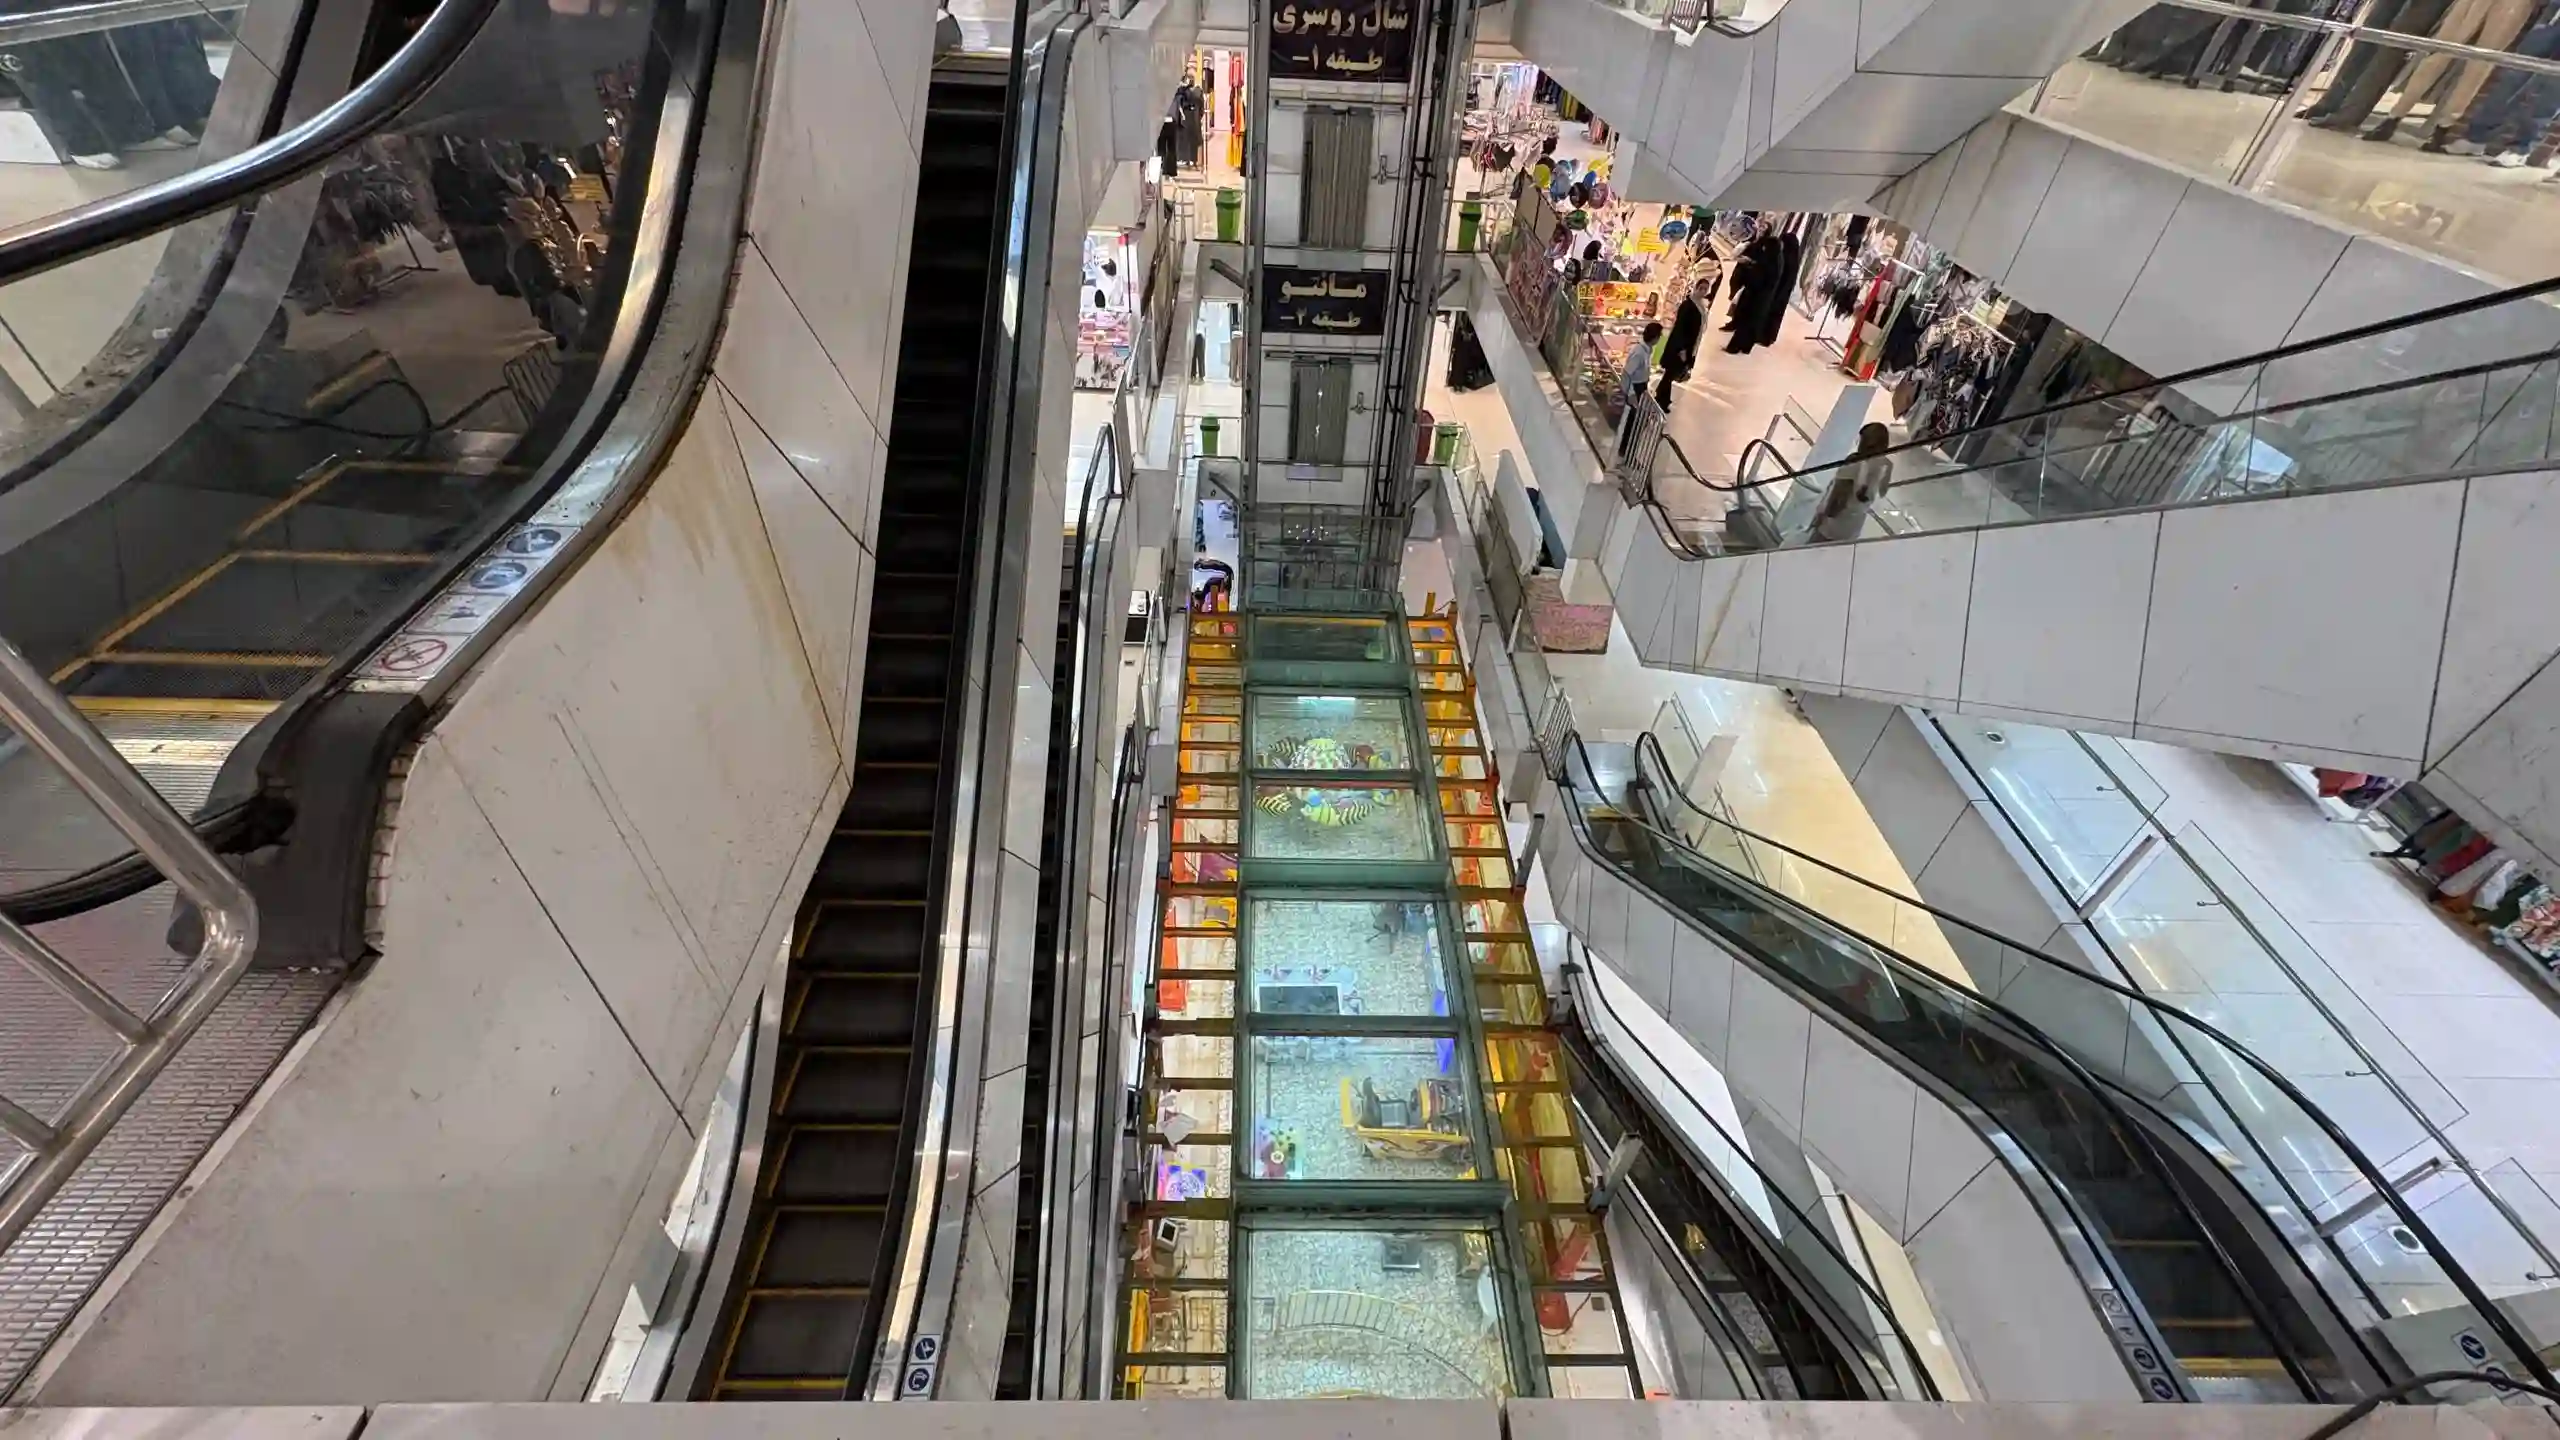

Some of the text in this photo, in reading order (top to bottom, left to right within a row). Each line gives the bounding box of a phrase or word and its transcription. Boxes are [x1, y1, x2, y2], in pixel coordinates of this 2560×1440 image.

[1273, 0, 1409, 37] شال روسری
[1326, 47, 1383, 76] طبقه
[1278, 272, 1367, 303] مانتو
[1312, 310, 1361, 332] طبقه
